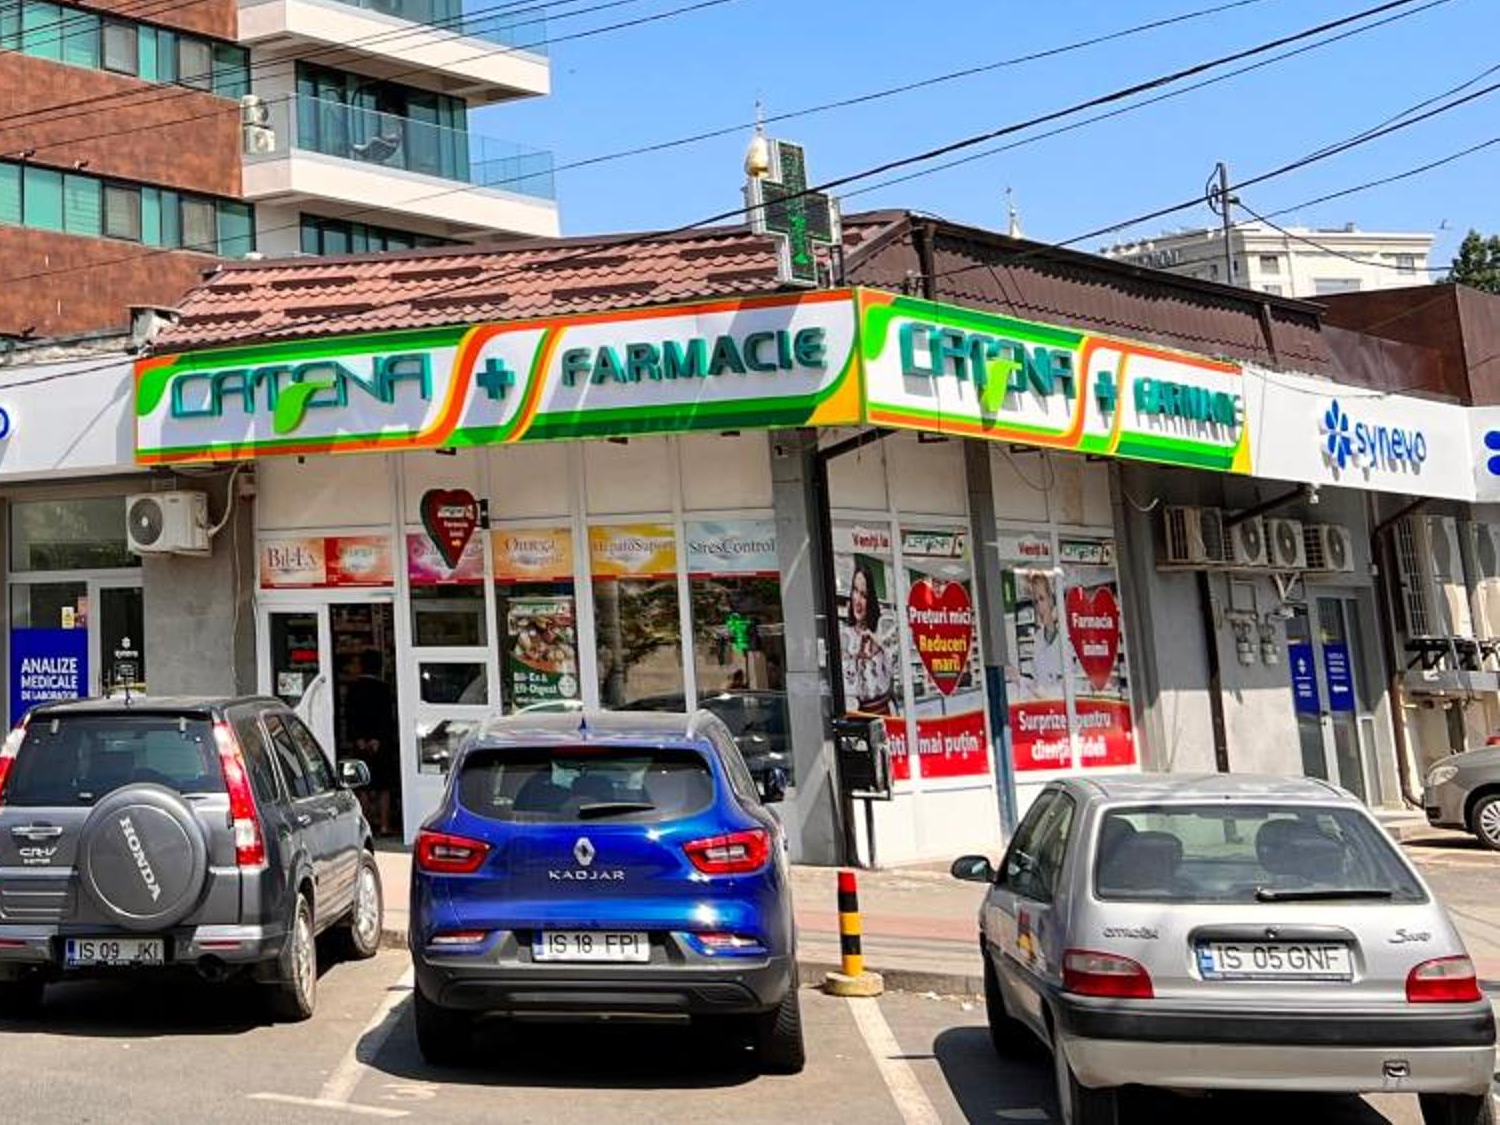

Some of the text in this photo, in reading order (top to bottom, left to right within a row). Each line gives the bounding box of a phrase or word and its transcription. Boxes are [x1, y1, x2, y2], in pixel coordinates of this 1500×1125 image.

[561, 327, 828, 387] FARMACIE
[898, 321, 1076, 402] CATENA
[171, 352, 433, 418] CATENA
[1355, 422, 1427, 467] synevo
[21, 657, 78, 674] ANALIZE
[21, 674, 78, 689] MEDICALE
[19, 846, 58, 857] CR-V
[119, 815, 161, 903] HONDA
[549, 869, 626, 881] KADJAR
[79, 942, 95, 959] IS
[100, 942, 119, 959] 09
[549, 934, 639, 954] IS 18 FPI
[1217, 944, 1340, 970] IS 05 GNF
